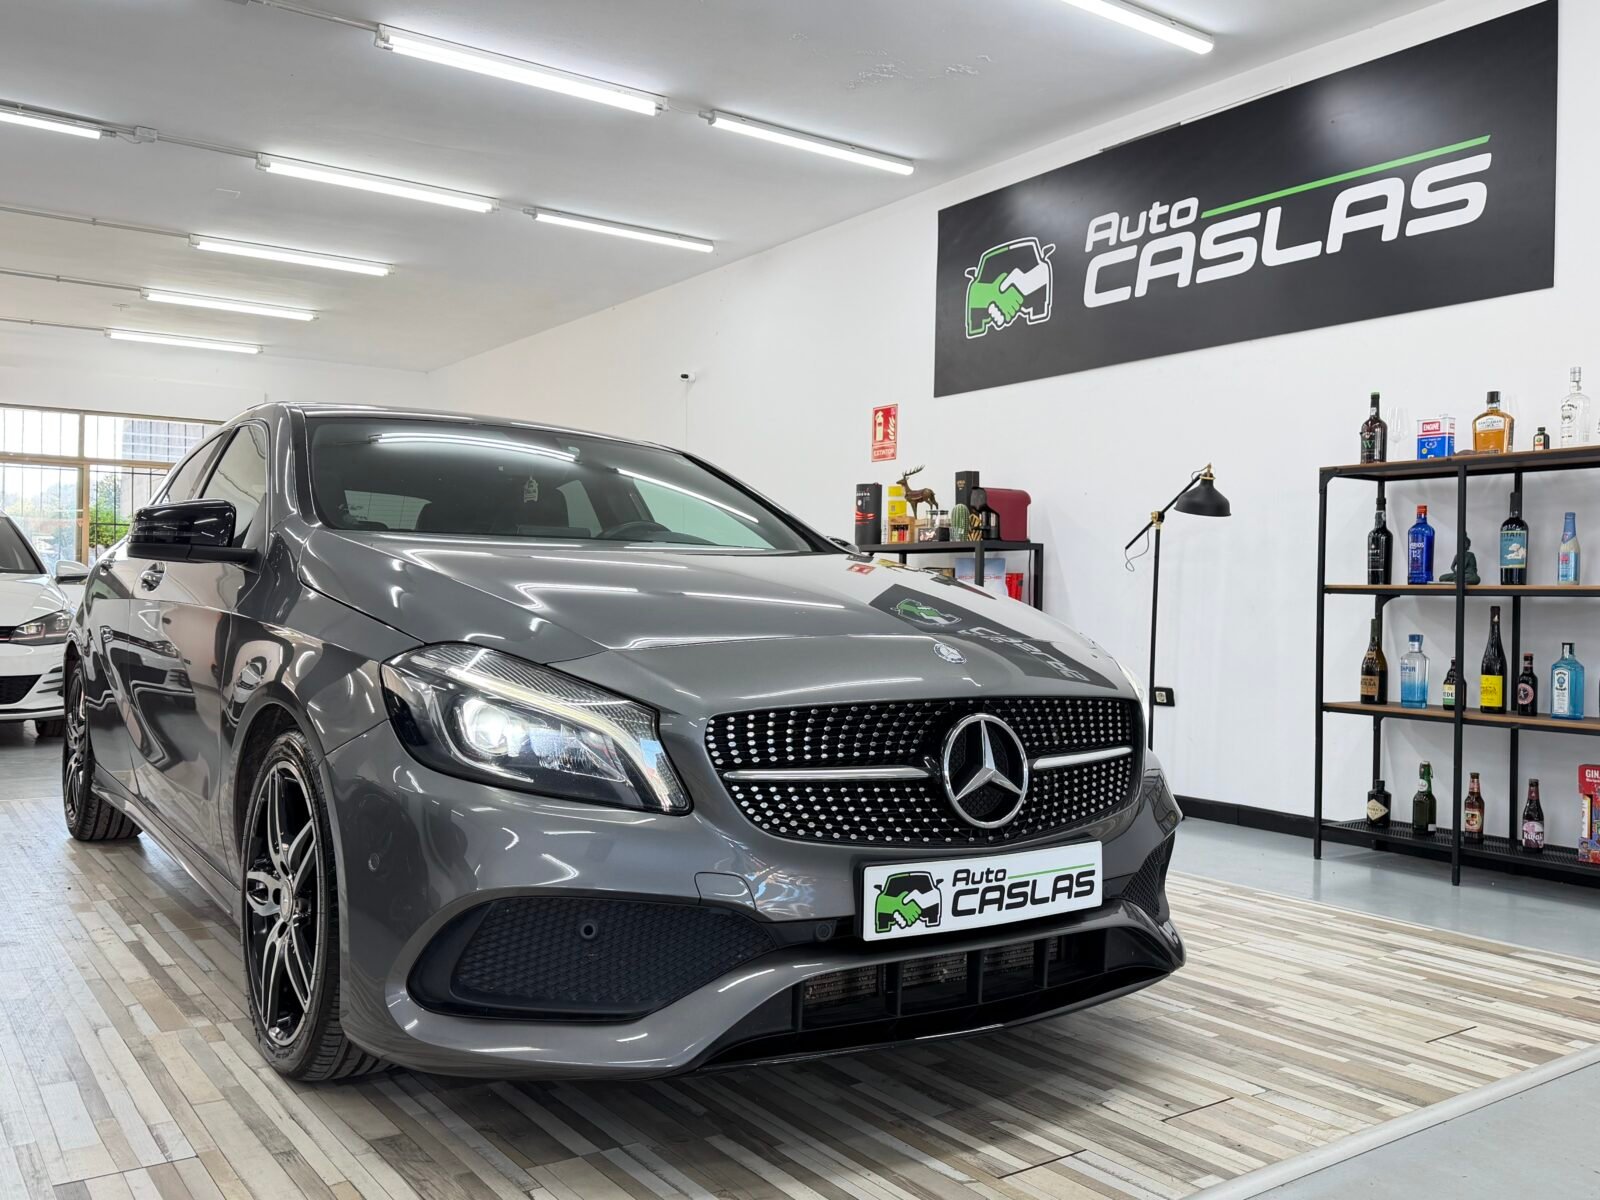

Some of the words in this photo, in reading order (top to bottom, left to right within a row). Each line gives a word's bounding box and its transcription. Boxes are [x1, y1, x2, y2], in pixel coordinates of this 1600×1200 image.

[1083, 152, 1492, 308] CASLAS
[1085, 197, 1199, 253] Auto
[1585, 769, 1600, 779] GIN
[951, 867, 1007, 887] Auto
[951, 869, 1096, 917] CASLAS
